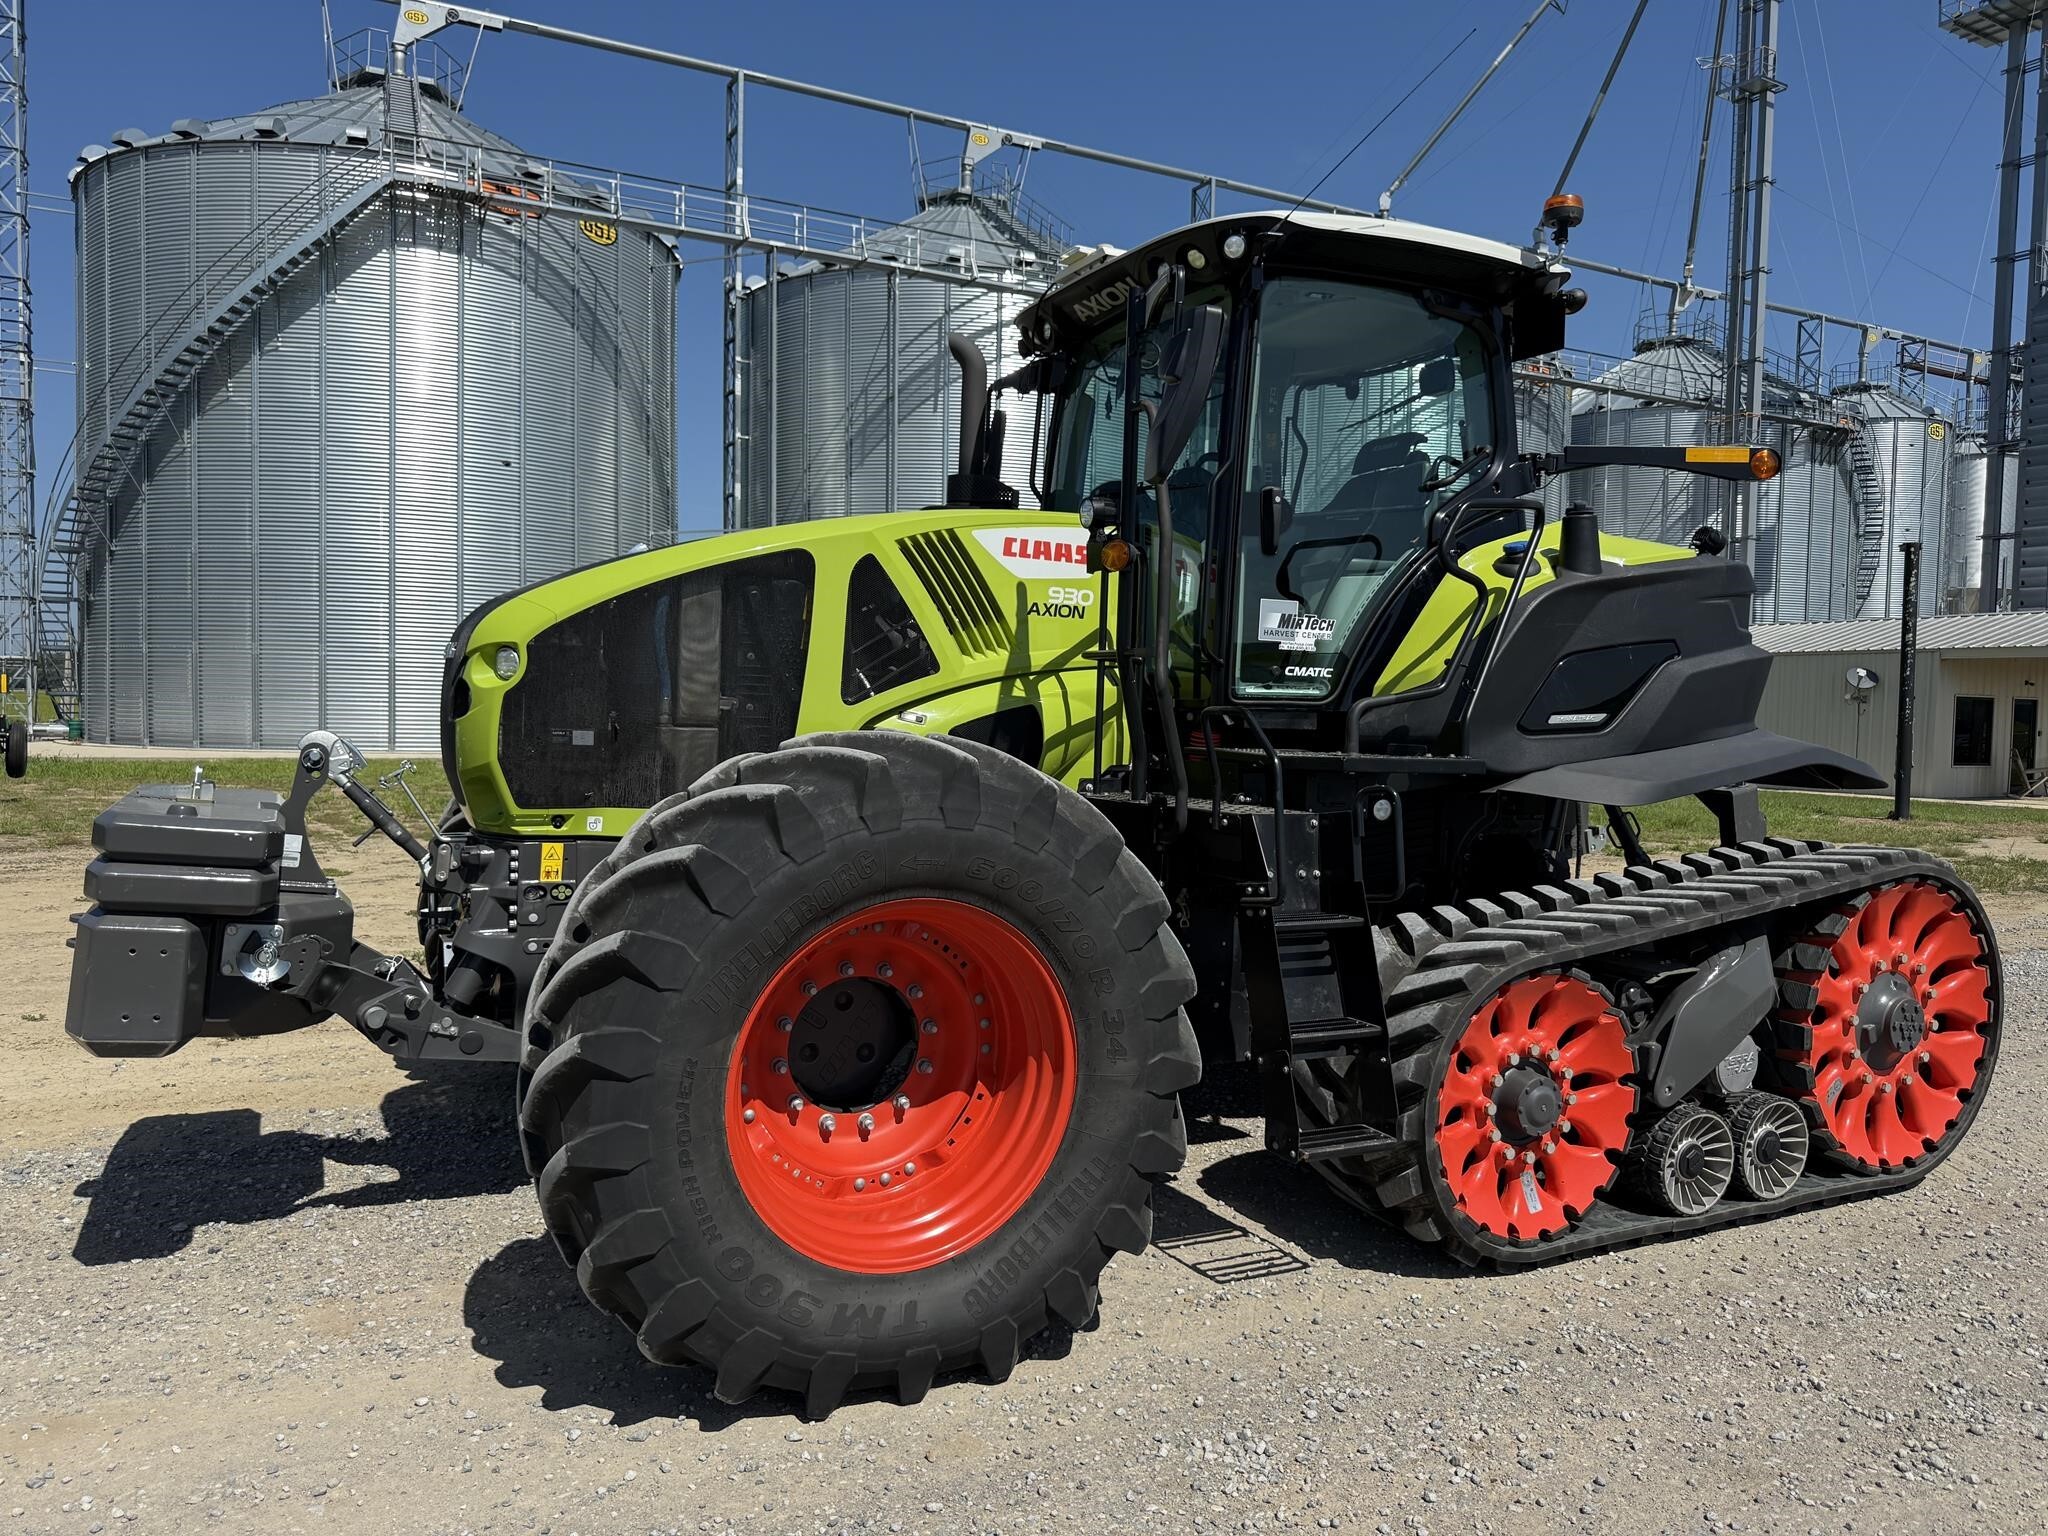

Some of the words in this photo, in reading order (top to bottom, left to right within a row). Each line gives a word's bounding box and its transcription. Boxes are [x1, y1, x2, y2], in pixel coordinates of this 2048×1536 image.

[583, 219, 614, 241] GSI
[1072, 276, 1137, 322] AXION
[1002, 536, 1087, 565] CLAAS
[1026, 602, 1086, 619] AXION
[1047, 586, 1095, 607] 930
[1263, 629, 1299, 638] HARVEST
[1284, 666, 1334, 678] CMATIC
[692, 849, 878, 1015] TRELLEBORG
[1102, 1008, 1128, 1064] 34
[675, 1056, 699, 1170] POWER
[682, 1175, 723, 1248] HIGH
[961, 1155, 1113, 1319] TRELLEBORG
